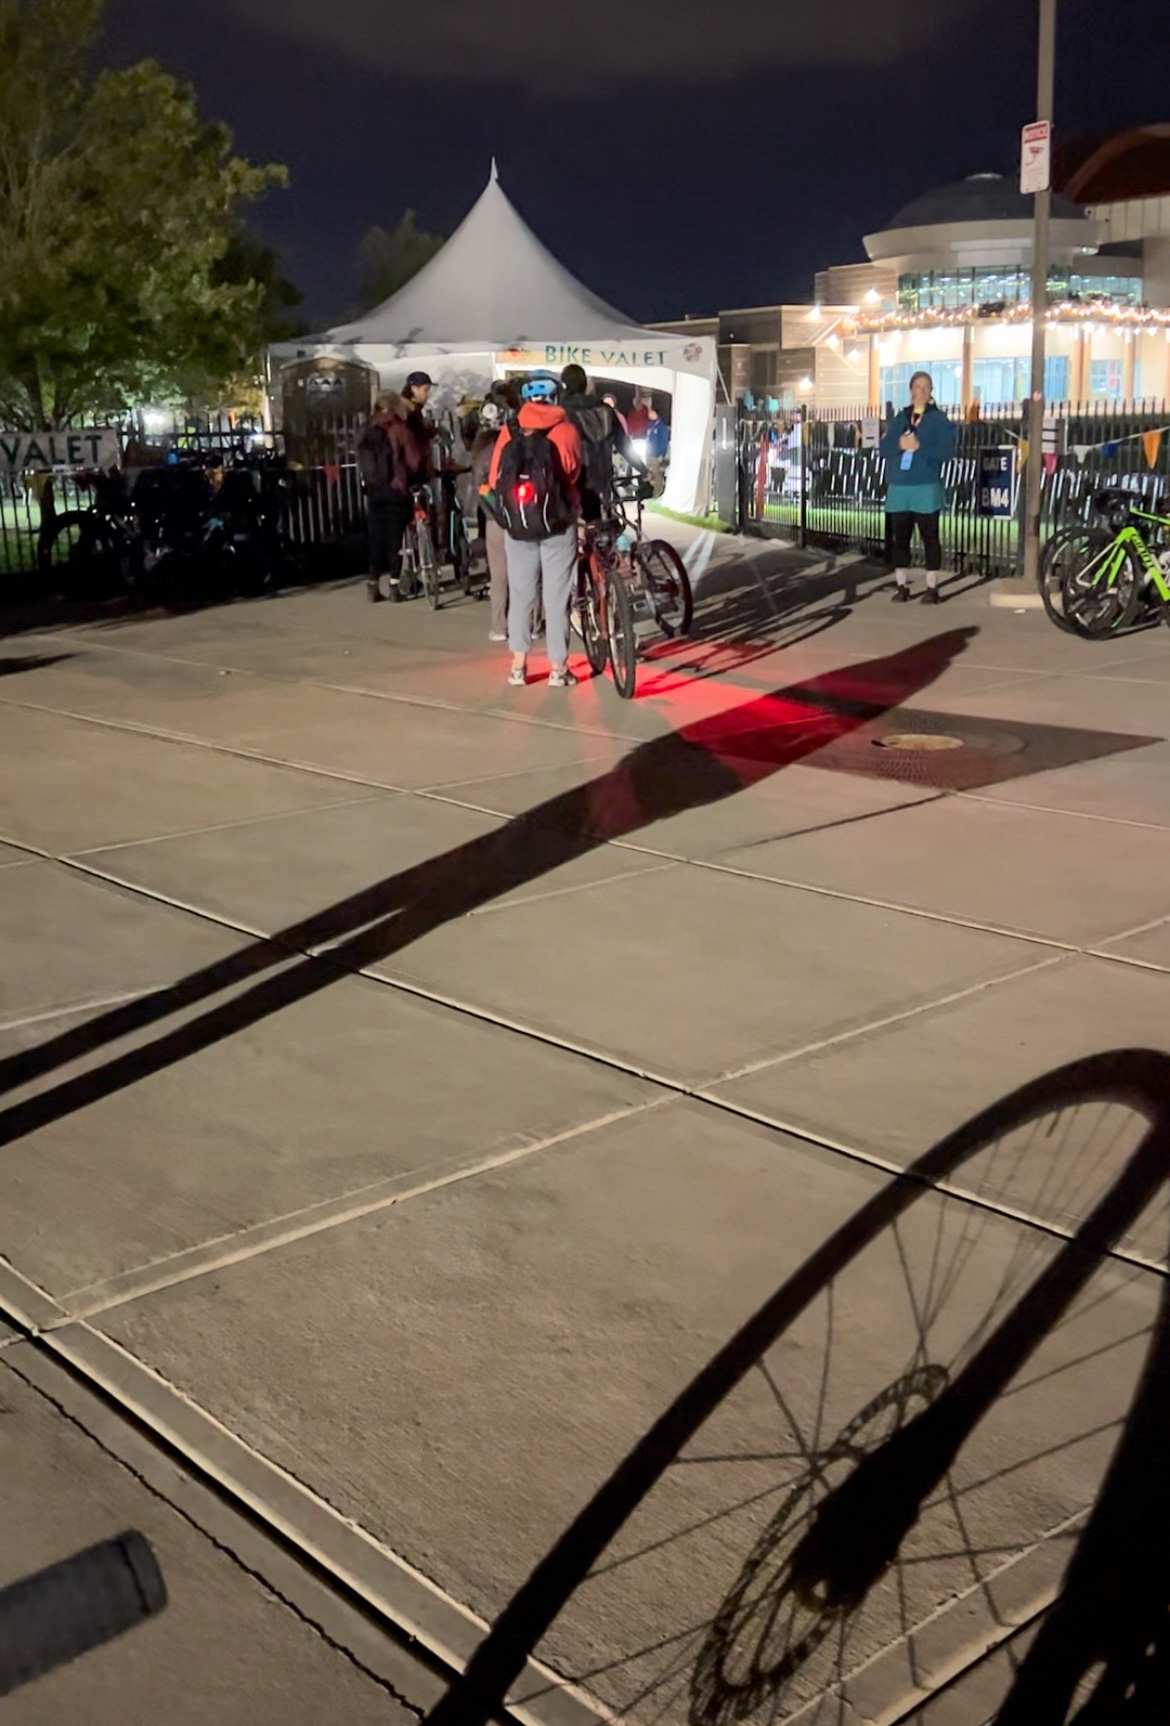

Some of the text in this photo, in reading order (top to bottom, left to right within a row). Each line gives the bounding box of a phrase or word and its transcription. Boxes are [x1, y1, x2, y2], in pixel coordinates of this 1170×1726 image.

[545, 345, 667, 366] BIKE VALET
[0, 435, 102, 466] VALET
[983, 456, 1007, 471] GATE
